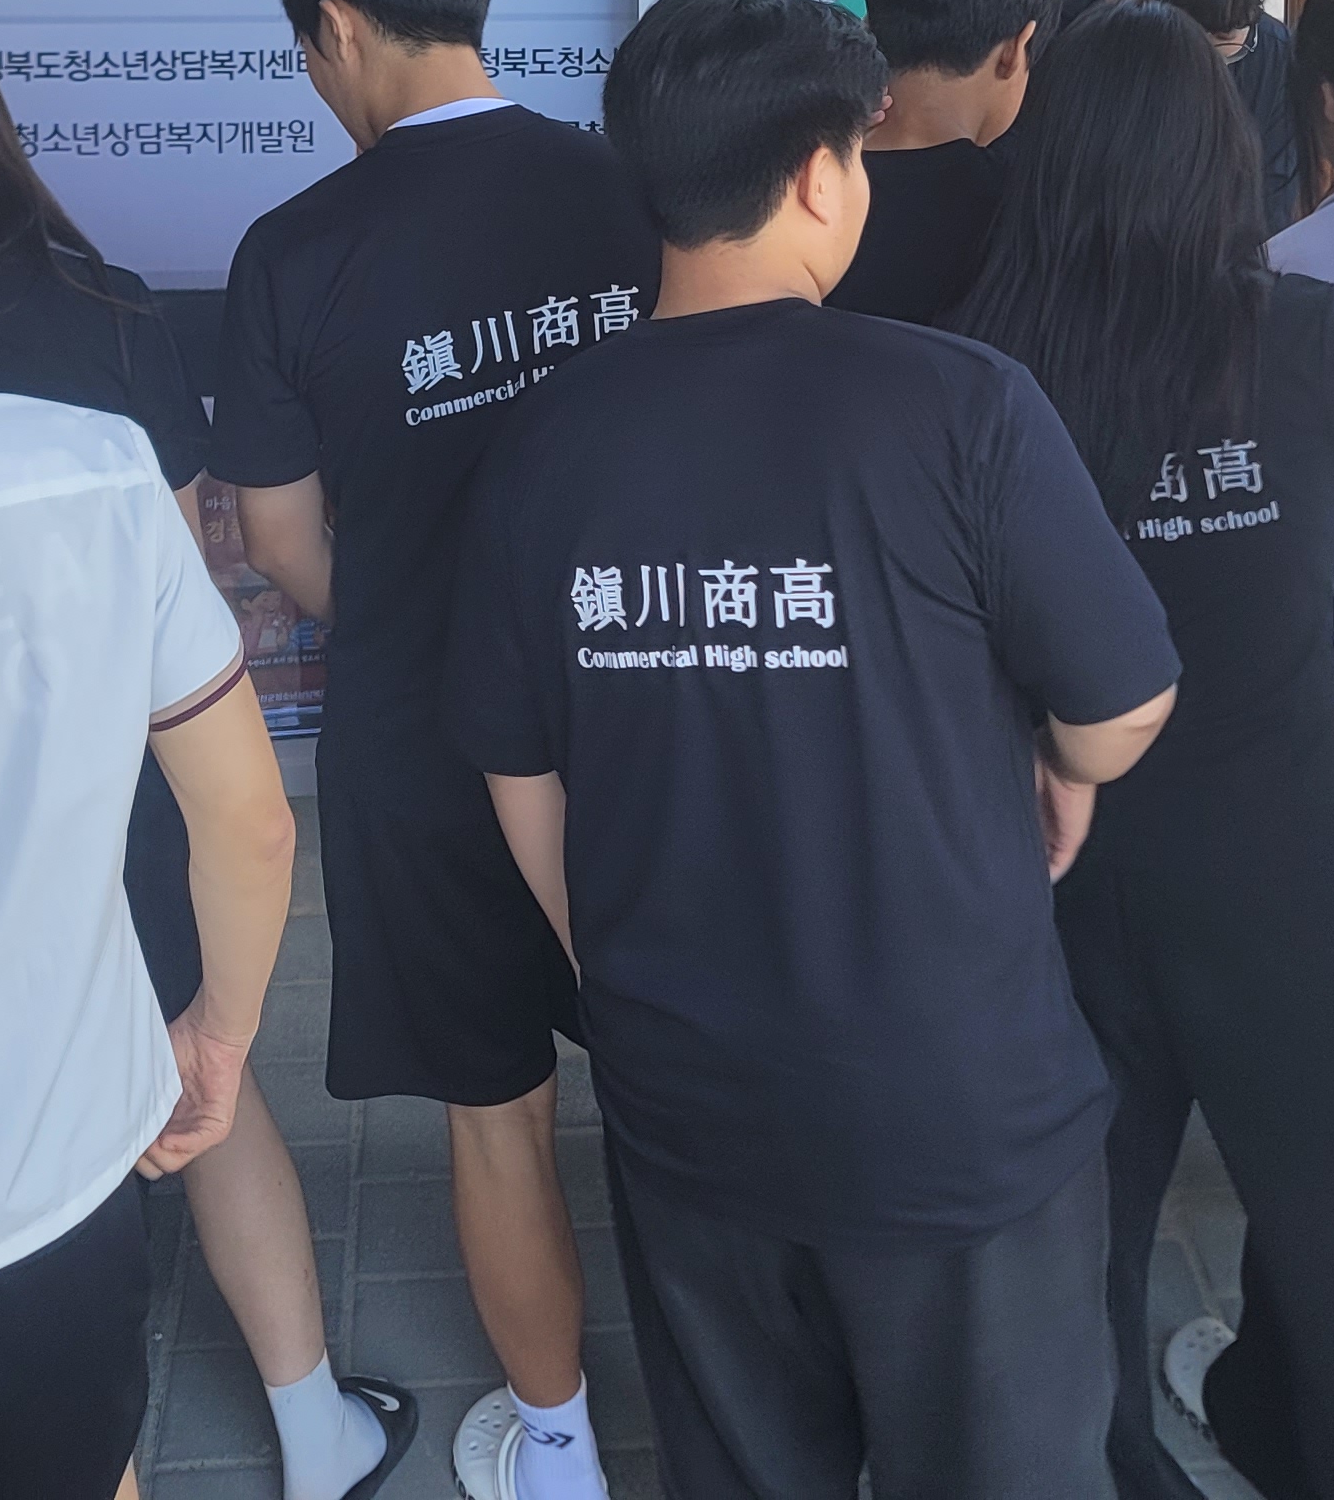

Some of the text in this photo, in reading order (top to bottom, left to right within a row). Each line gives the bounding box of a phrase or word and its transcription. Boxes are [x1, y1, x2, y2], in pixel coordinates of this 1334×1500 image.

[480, 46, 616, 78] 청북도청소
[14, 118, 316, 158] 청소년상담복지개발원
[1136, 514, 1194, 542] High
[1199, 500, 1281, 535] school
[577, 644, 850, 672] Commercial High school
